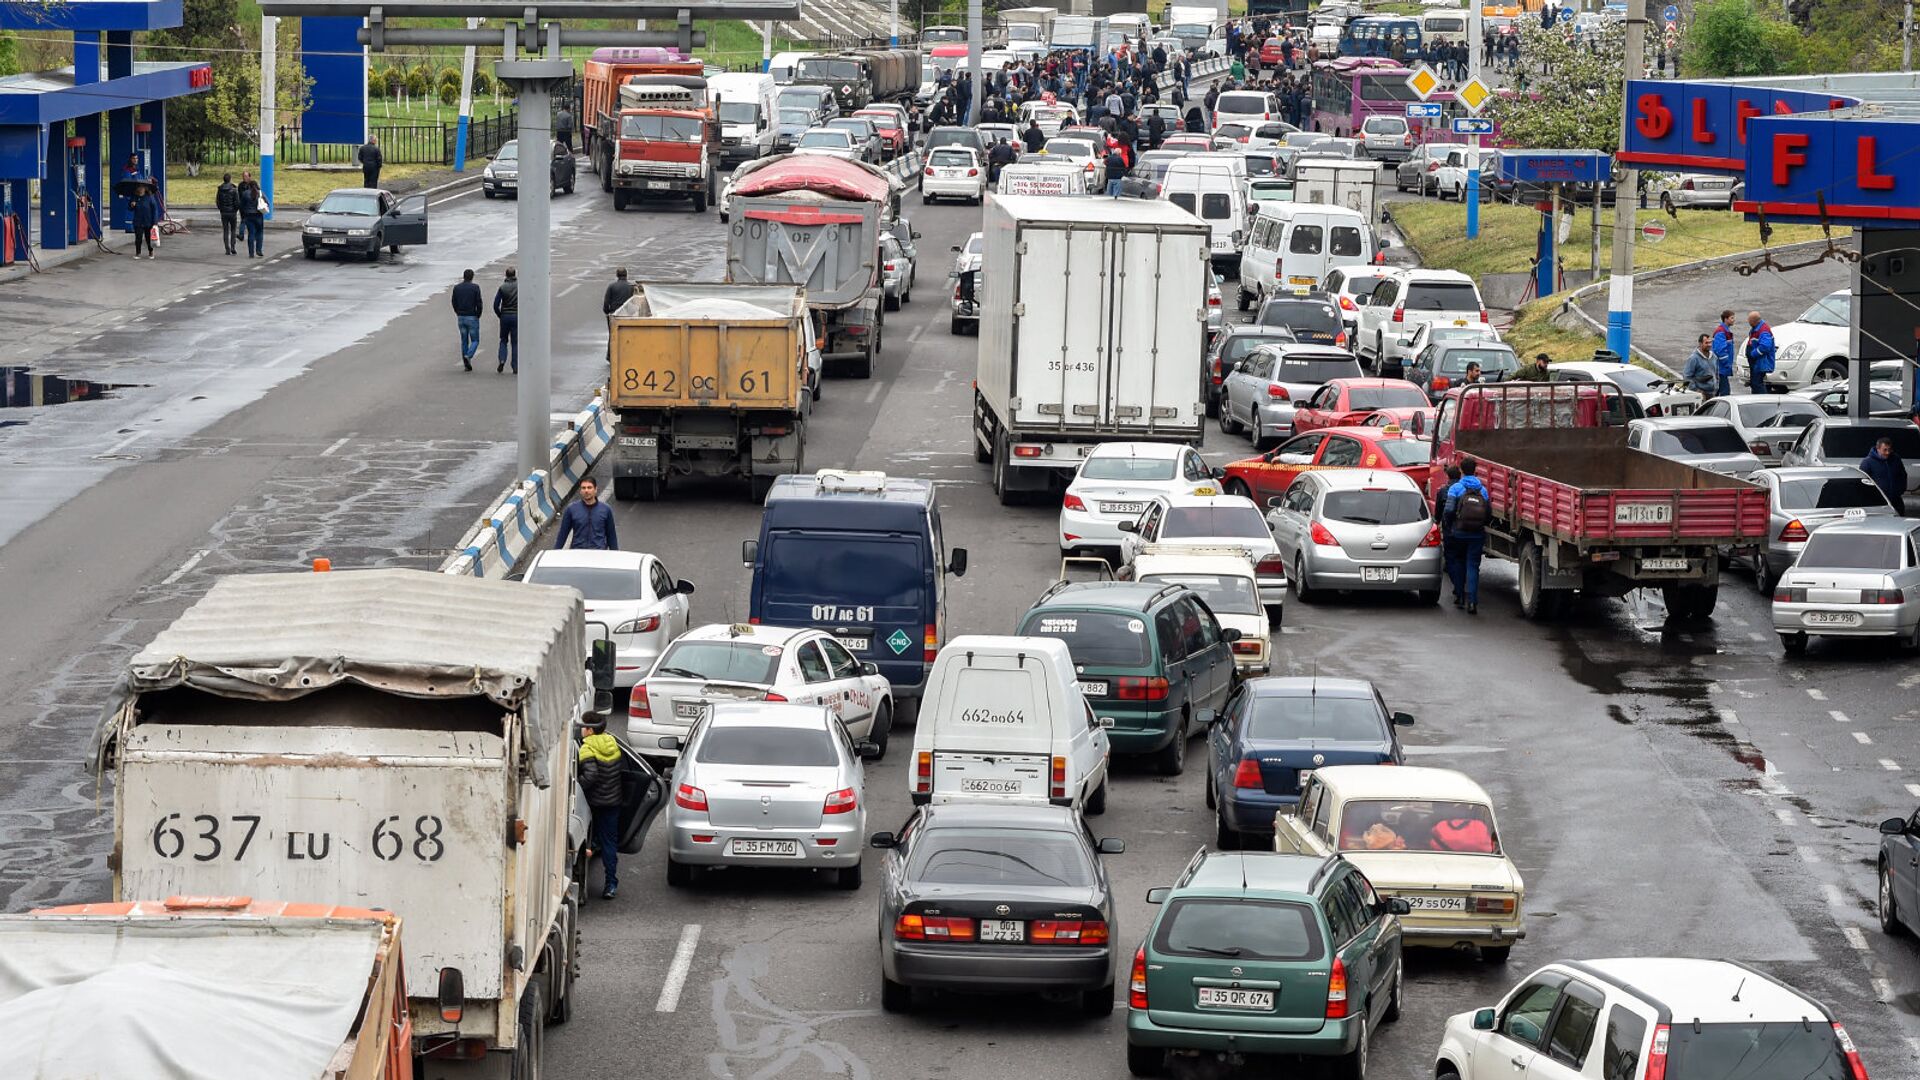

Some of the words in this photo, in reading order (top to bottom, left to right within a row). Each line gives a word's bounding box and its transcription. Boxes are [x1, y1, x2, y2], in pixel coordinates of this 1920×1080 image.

[1048, 361, 1061, 370] 35
[1076, 362, 1094, 371] 436
[624, 368, 676, 392] 842
[740, 370, 769, 393] 61
[1657, 506, 1670, 520] 61
[812, 605, 837, 620] 017
[839, 609, 853, 620] AC
[856, 606, 874, 621] 61
[855, 640, 865, 649] 61
[890, 638, 907, 646] CNG
[1087, 684, 1104, 692] 882
[687, 705, 698, 715] 35
[970, 782, 988, 791] 662
[1004, 782, 1017, 792] 64
[153, 813, 261, 862] 637
[287, 831, 330, 860] LU
[372, 815, 445, 862] 68
[746, 842, 758, 851] 35
[760, 842, 774, 852] FM
[776, 842, 793, 852] 706
[1410, 898, 1423, 907] 29
[1440, 898, 1461, 909] 094
[1000, 921, 1016, 931] 001
[994, 931, 1005, 940] ZZ
[1010, 931, 1021, 940] 55
[1214, 990, 1227, 1003] 35
[1231, 991, 1245, 1004] QR
[1250, 993, 1269, 1005] 674
